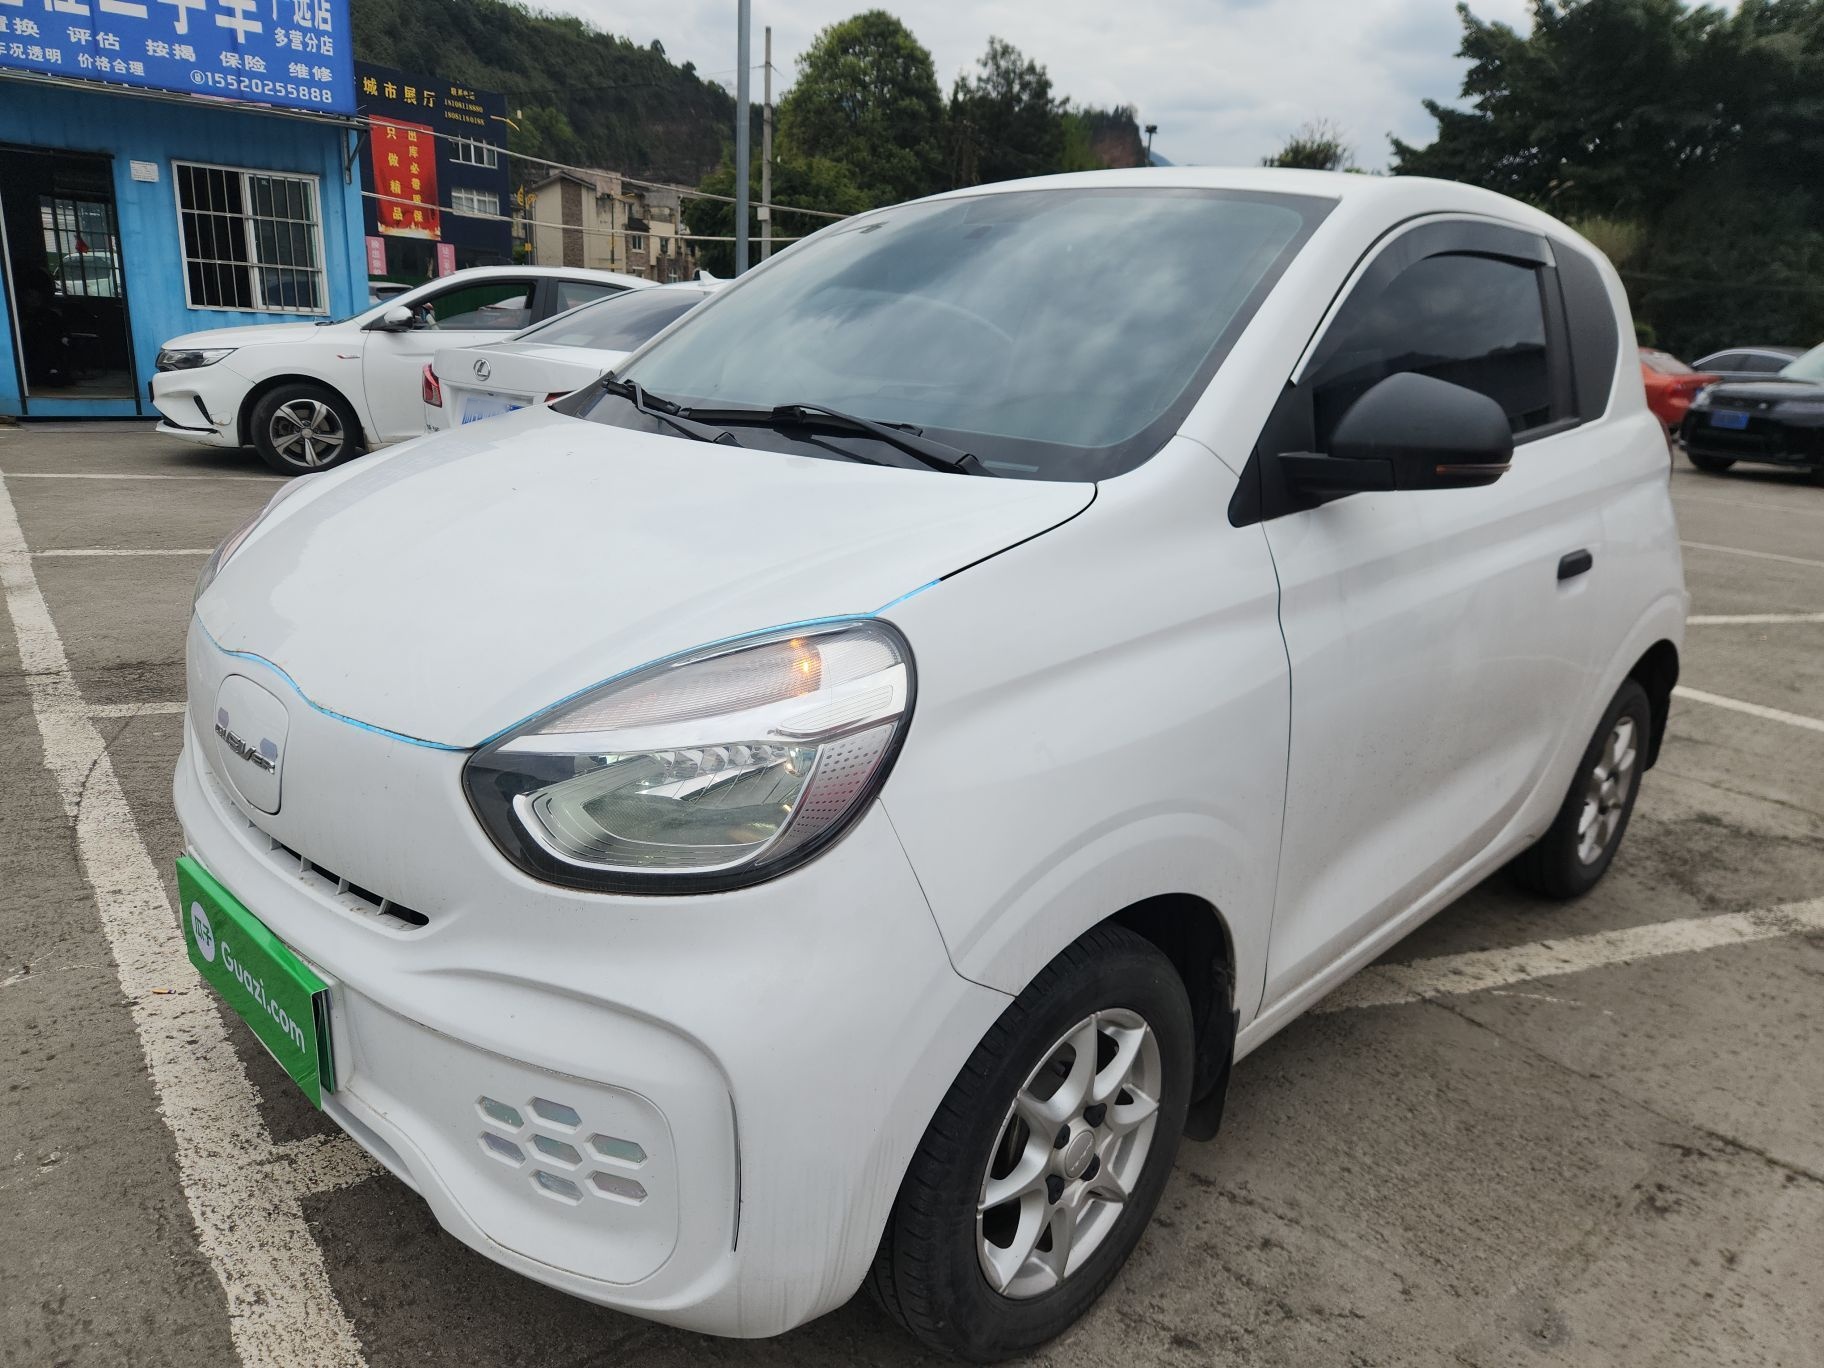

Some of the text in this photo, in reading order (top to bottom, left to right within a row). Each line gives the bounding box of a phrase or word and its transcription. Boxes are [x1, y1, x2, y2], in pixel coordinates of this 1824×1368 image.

[66, 26, 121, 50] 评估
[145, 39, 196, 62] 按揭
[220, 51, 267, 73] 保险
[288, 62, 333, 81] 维修
[274, 27, 333, 56] 多营分店
[78, 53, 145, 76] 价格合理
[205, 72, 332, 103] 15520255888
[363, 76, 436, 108] 城市展厅
[386, 126, 403, 222] 只做精品
[220, 941, 306, 1054] Guazi.com
